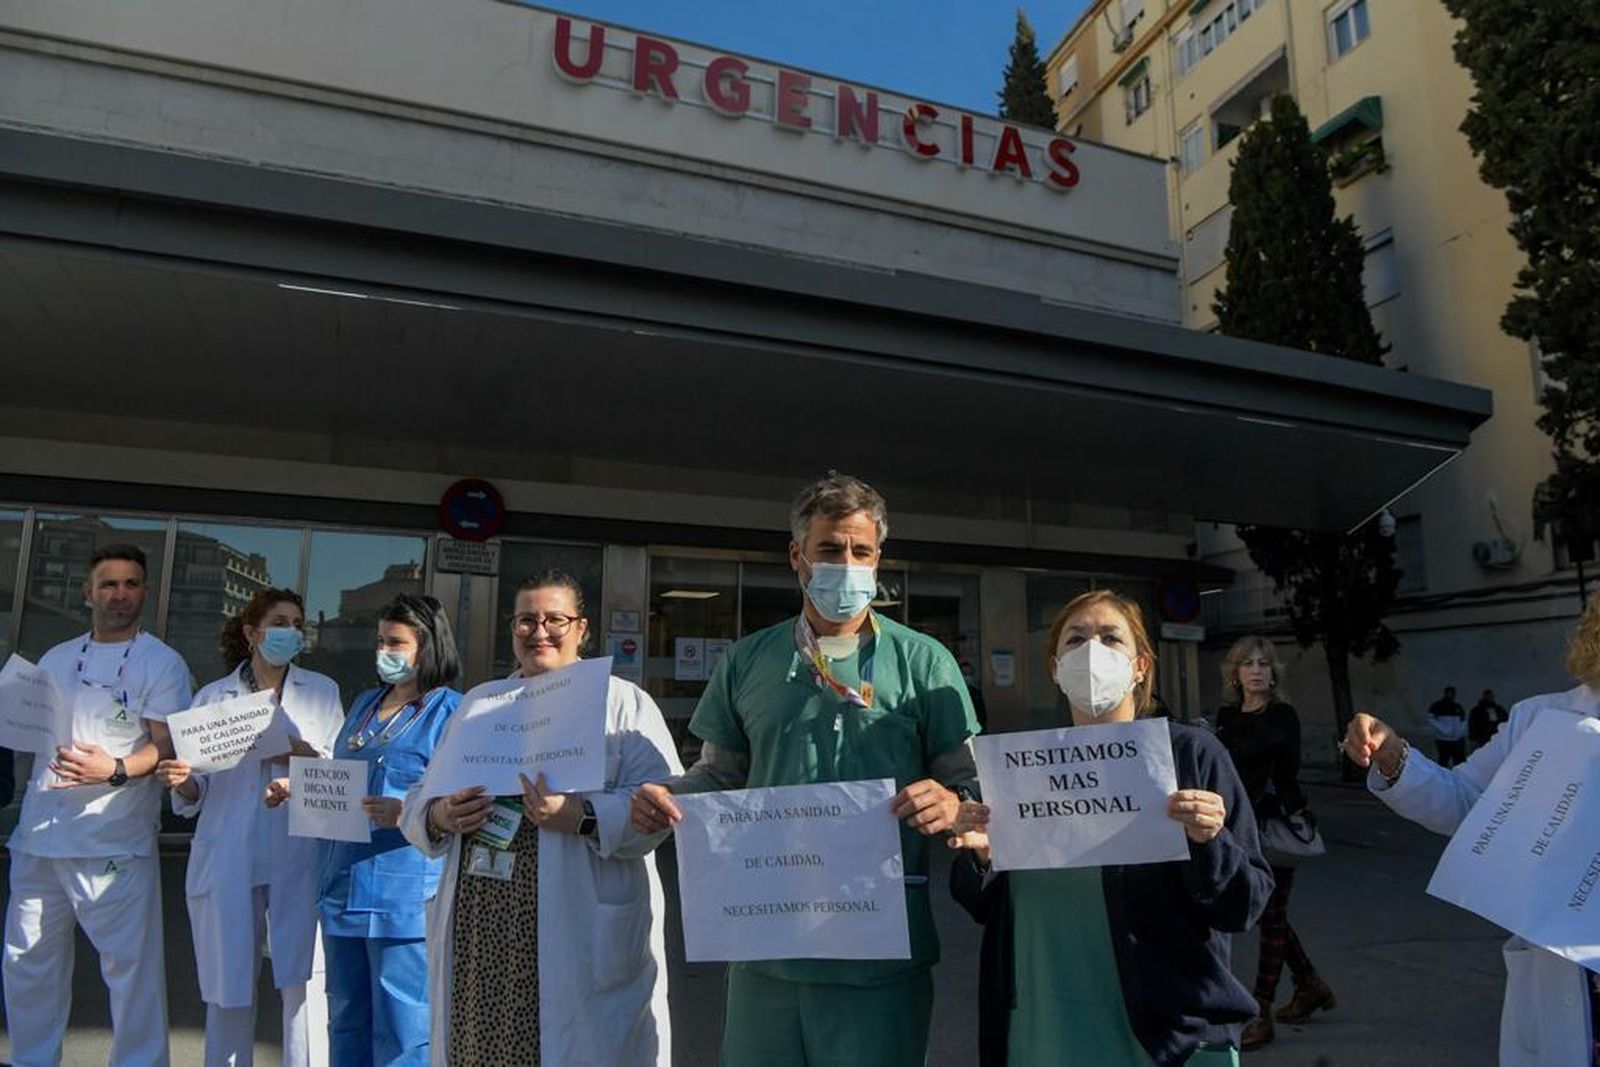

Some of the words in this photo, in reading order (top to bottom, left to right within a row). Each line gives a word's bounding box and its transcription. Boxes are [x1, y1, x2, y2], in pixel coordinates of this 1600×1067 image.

[553, 16, 1081, 190] URGENCIAS
[180, 724, 205, 738] PARA
[207, 718, 228, 731] UNA
[228, 708, 269, 724] SANIDAD
[199, 734, 211, 744] DE
[200, 732, 262, 755] NECESITAMOS
[211, 744, 258, 762] PERSONAL
[1005, 740, 1138, 768] NESITAMOS
[304, 768, 350, 780] ATENCION
[1049, 771, 1099, 792] MAS
[304, 784, 334, 796] DIGNA
[336, 785, 347, 796] AL
[304, 798, 350, 812] PACIENTE
[1018, 795, 1141, 819] PERSONAL
[1472, 825, 1497, 856] PARA
[1494, 802, 1514, 826] UNA
[1511, 750, 1544, 803] SANIDAD
[719, 811, 752, 824] PARA
[755, 808, 782, 822] UNA
[782, 805, 842, 820] SANIDAD
[1531, 834, 1549, 856] DE
[744, 858, 760, 870] DE
[724, 901, 811, 918] NECESITAMOS
